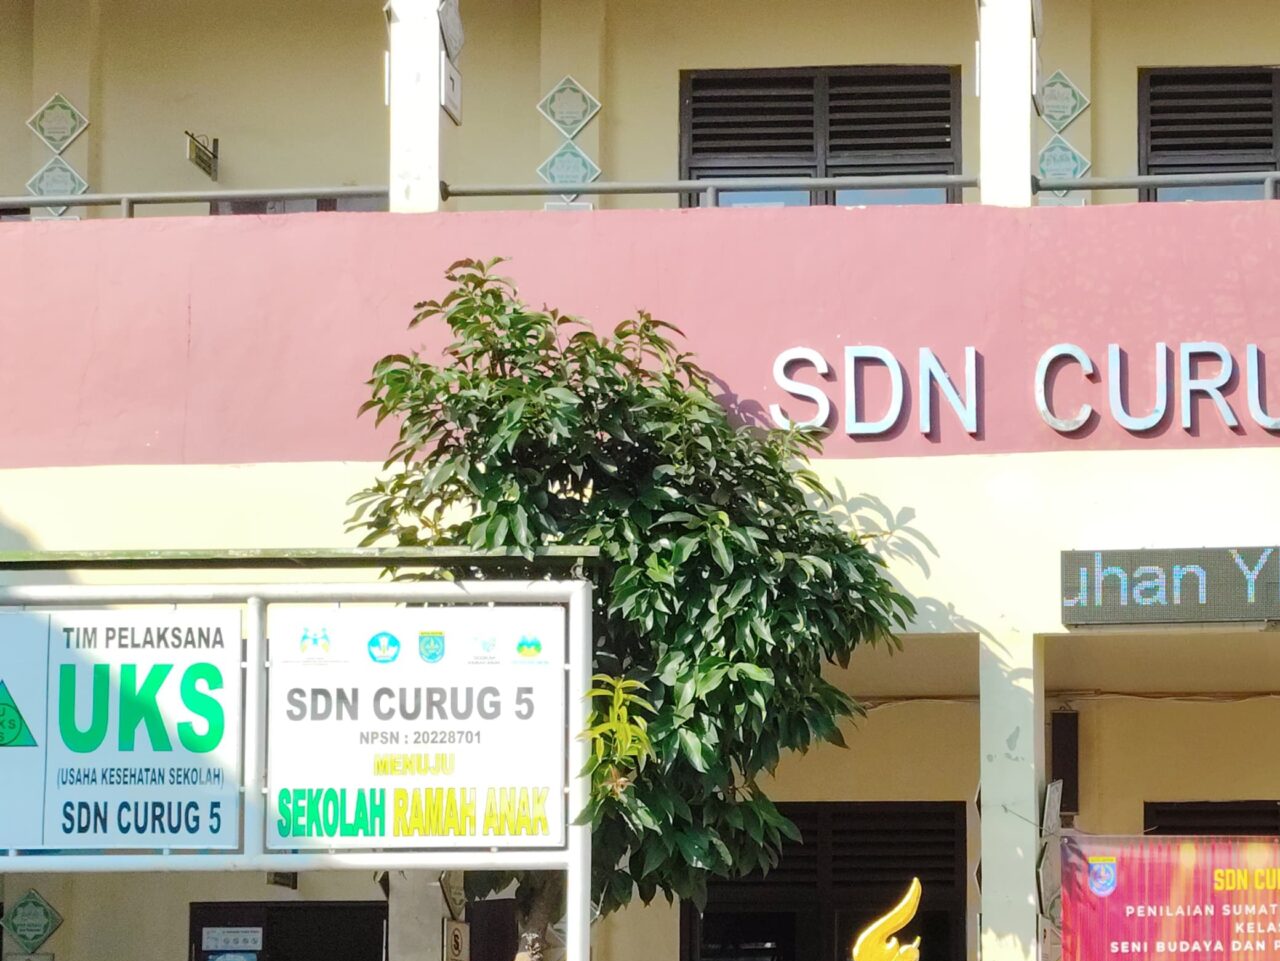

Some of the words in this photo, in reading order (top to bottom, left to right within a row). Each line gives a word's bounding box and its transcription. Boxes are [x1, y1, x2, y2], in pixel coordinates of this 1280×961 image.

[769, 345, 977, 434] SDN
[63, 627, 97, 649] TIM
[105, 627, 225, 649] PELAKSANA
[59, 662, 225, 754] UKS
[286, 687, 359, 721] SDN
[373, 686, 501, 721] CURUG
[514, 686, 535, 720] 5
[360, 731, 400, 745] NPSN
[413, 731, 481, 744] 20228701
[373, 753, 455, 776] MENUJU
[57, 768, 97, 790] (USAHA
[101, 768, 165, 786] KESEHATAN
[169, 768, 224, 789] SEKOLAH)
[62, 801, 108, 834] SDN
[117, 801, 200, 834] CURUG
[209, 801, 221, 834] 5
[277, 788, 386, 838] SEKOLAH
[393, 788, 476, 837] RAMAH
[482, 787, 550, 836] ANAK
[1214, 868, 1248, 891] SDN
[1125, 903, 1216, 918] PENILAIAN
[1110, 940, 1149, 954] SENI
[1155, 939, 1224, 953] BUDAYA
[1231, 939, 1268, 952] DAN
